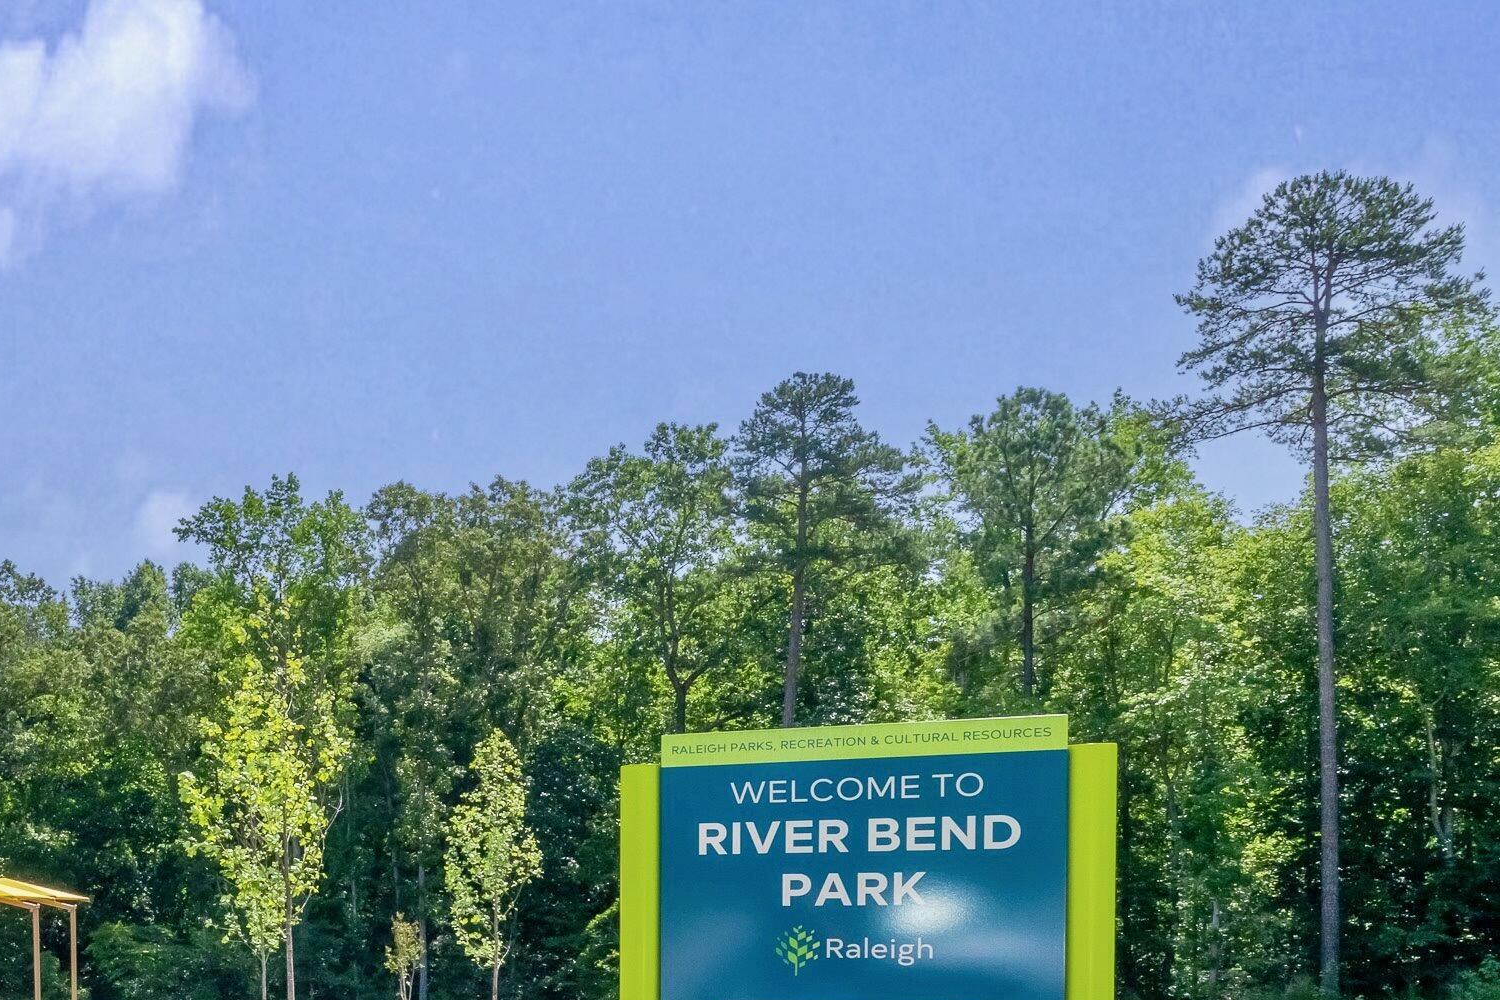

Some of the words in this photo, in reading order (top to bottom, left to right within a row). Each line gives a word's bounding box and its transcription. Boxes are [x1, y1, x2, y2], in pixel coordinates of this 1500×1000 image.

[671, 743, 726, 754] RALEIGH
[730, 741, 776, 751] PARKS,
[780, 736, 866, 749] RECREATION
[870, 735, 879, 745] &
[884, 732, 959, 744] CULTURAL
[963, 727, 1052, 740] RESOURCES
[730, 775, 920, 803] WELCOME
[931, 772, 984, 797] TO
[698, 819, 849, 854] RIVER
[868, 815, 1021, 851] BEND
[781, 871, 927, 907] PARK
[826, 937, 933, 965] Raleigh
